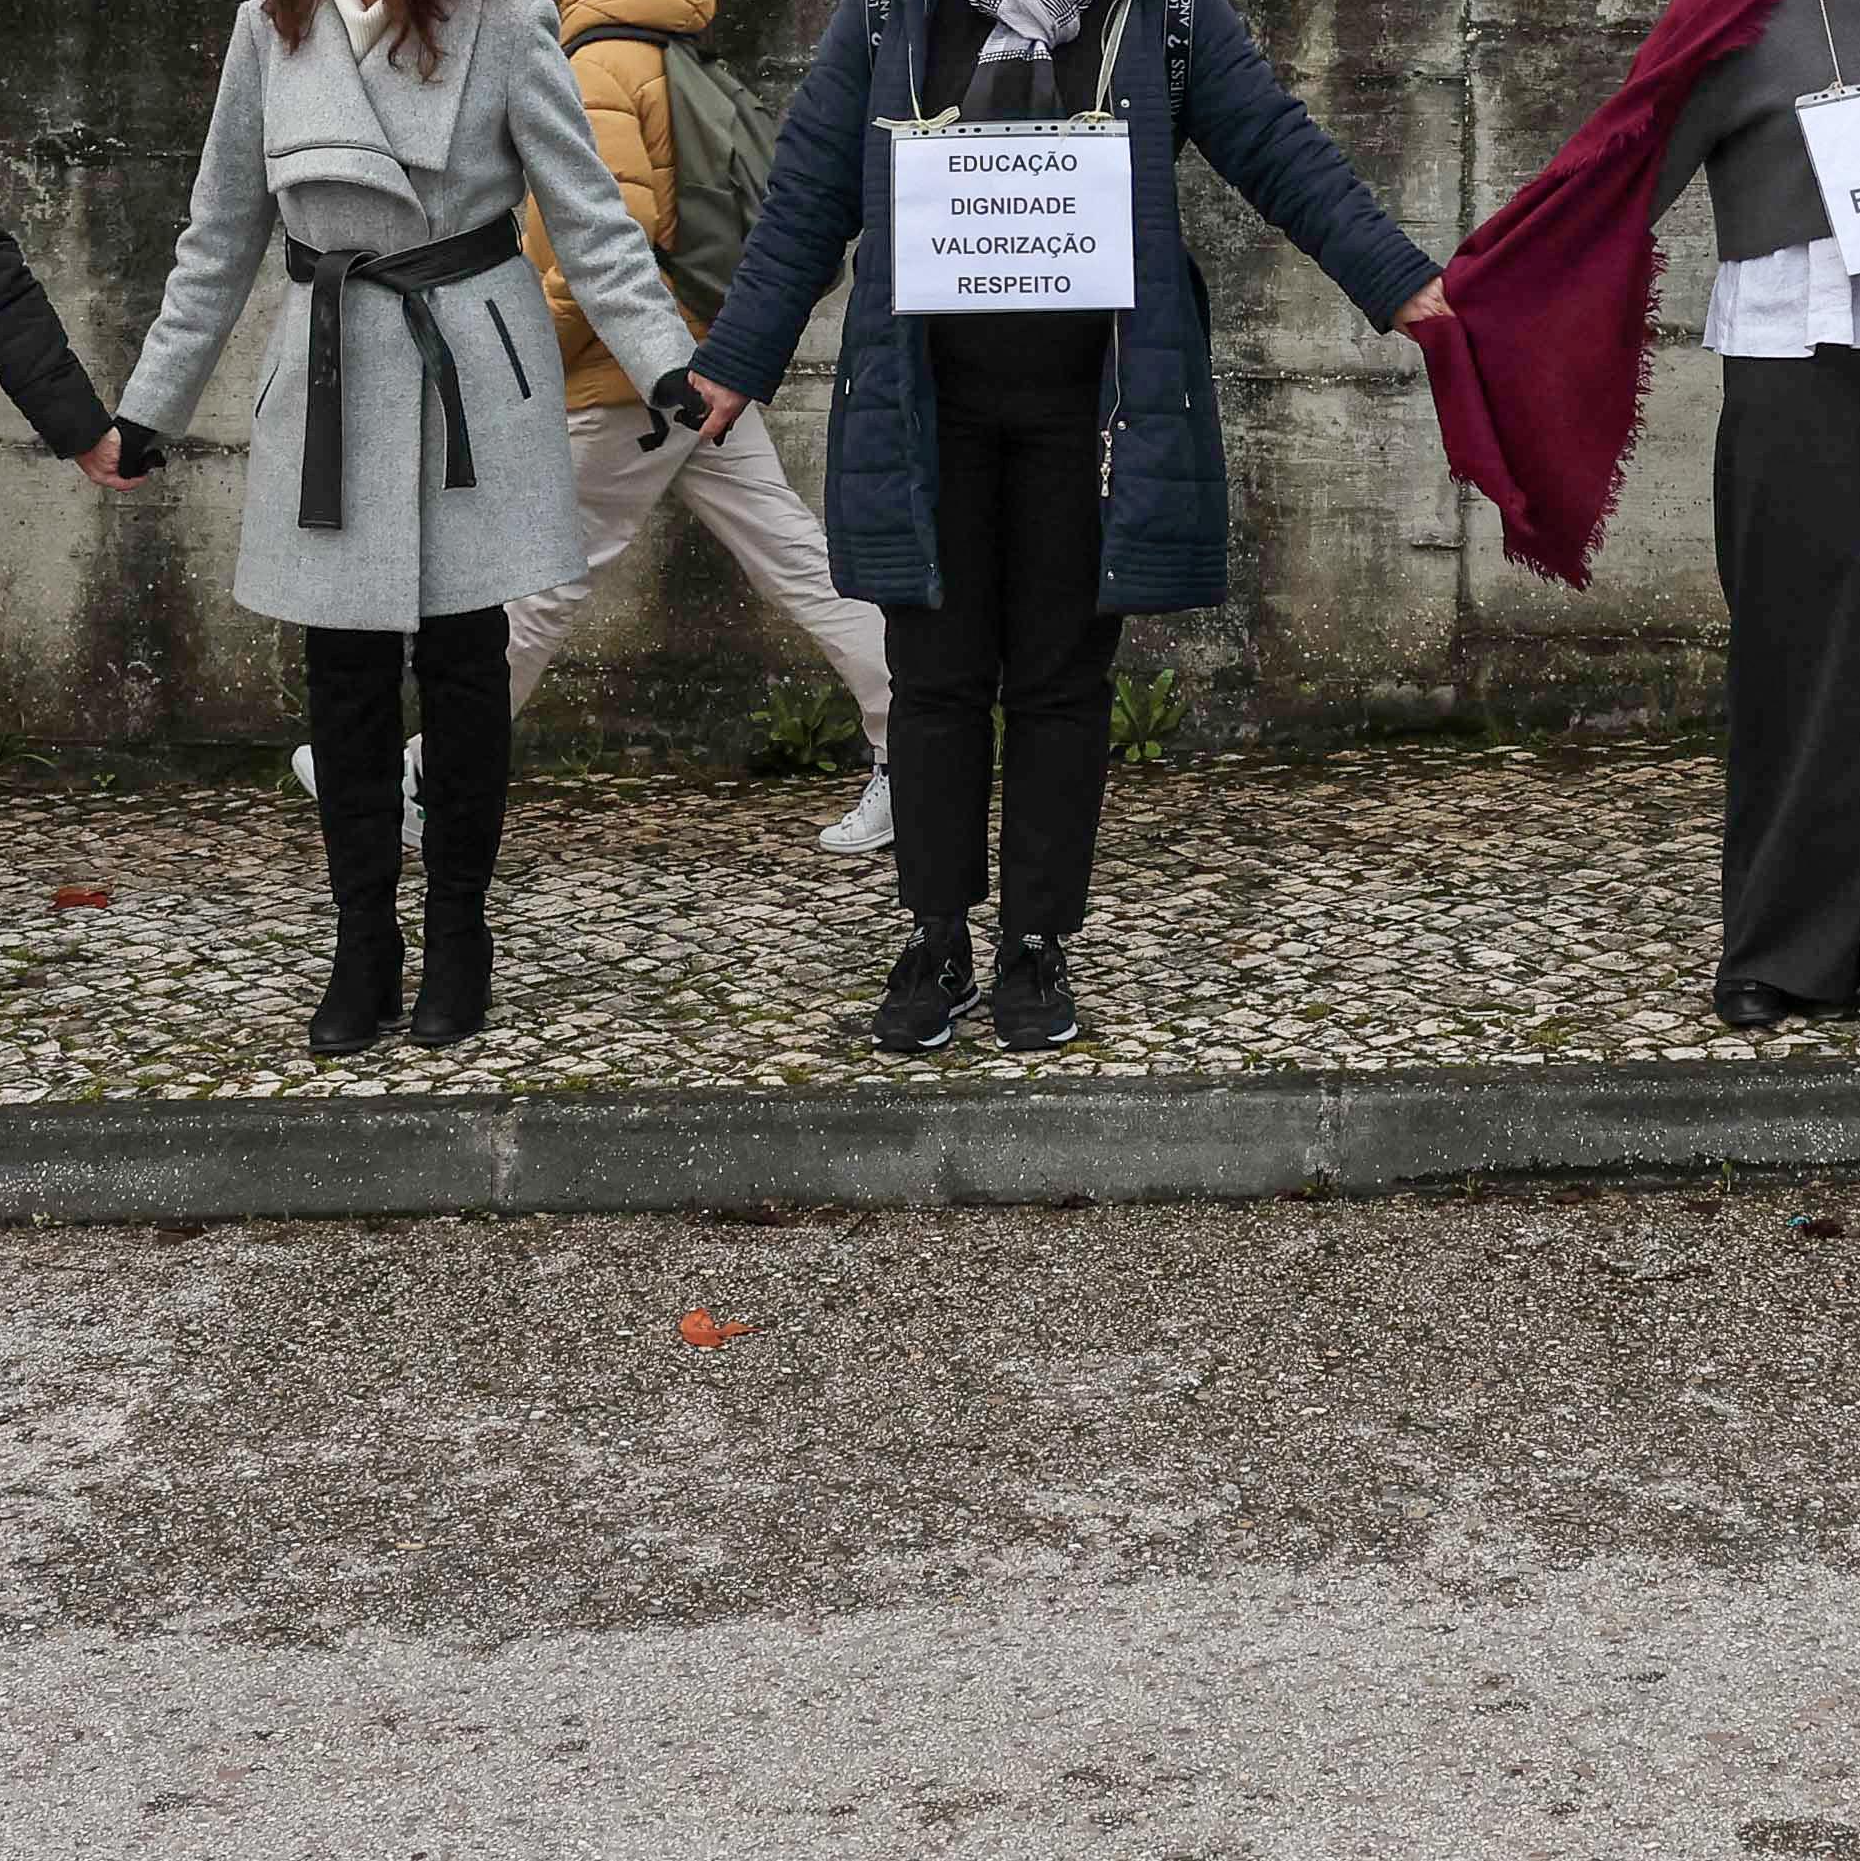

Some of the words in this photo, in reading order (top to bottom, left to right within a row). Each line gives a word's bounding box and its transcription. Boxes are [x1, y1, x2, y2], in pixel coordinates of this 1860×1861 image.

[948, 150, 1078, 176] EDUCAÇÃO
[950, 196, 1077, 216] DIGNIDADE
[931, 232, 1097, 258] VALORIZAÇÃO
[957, 275, 1071, 295] RESPEITO
